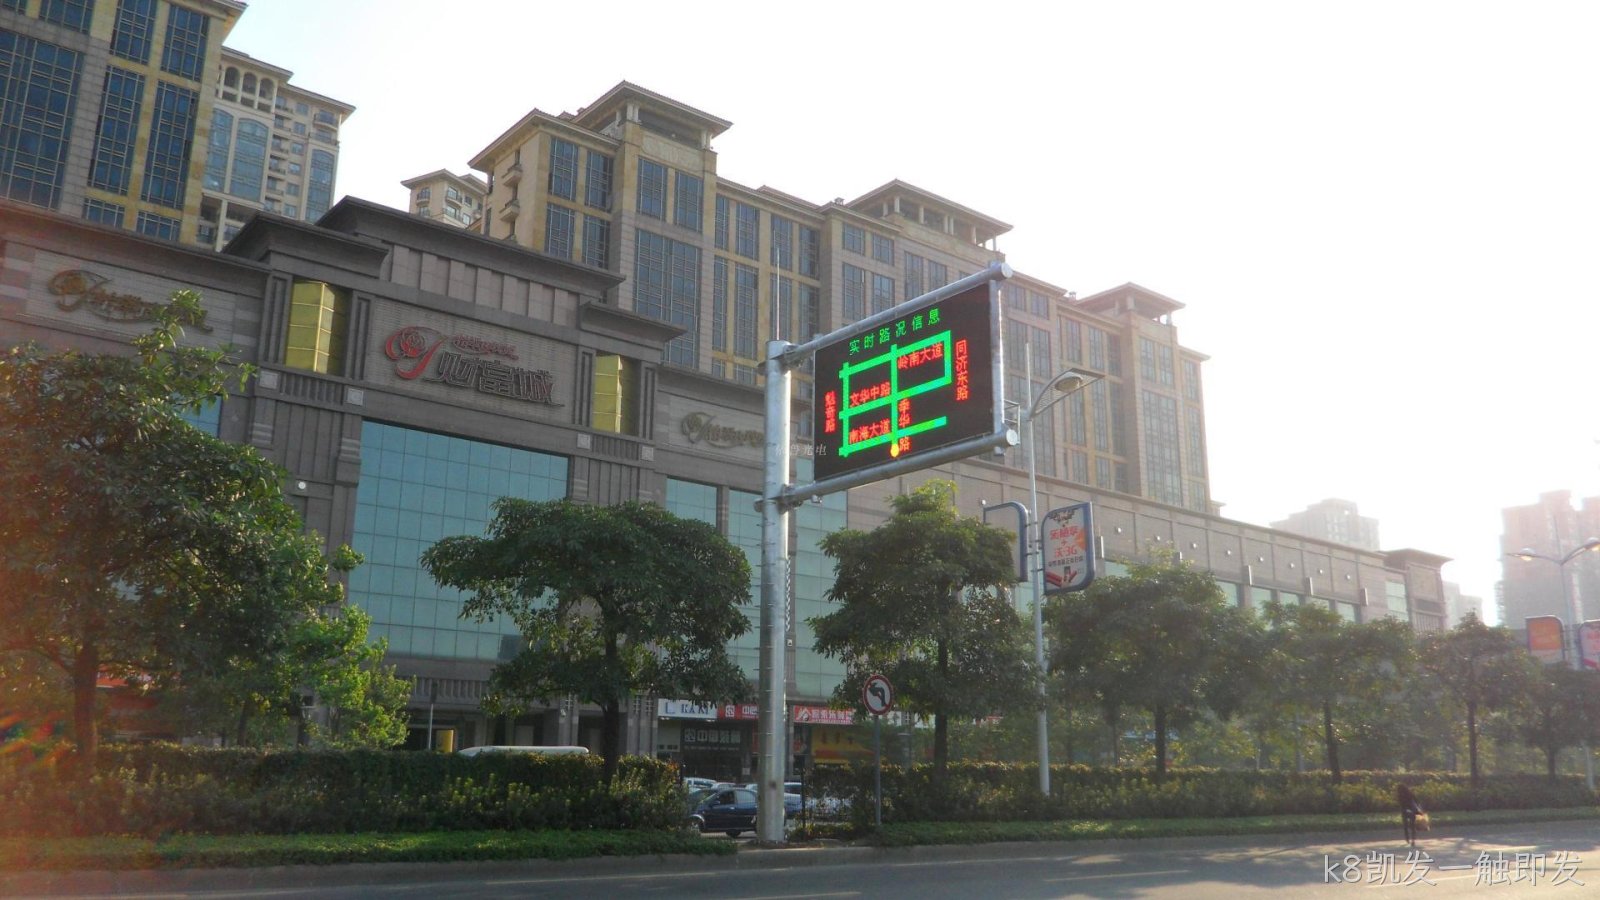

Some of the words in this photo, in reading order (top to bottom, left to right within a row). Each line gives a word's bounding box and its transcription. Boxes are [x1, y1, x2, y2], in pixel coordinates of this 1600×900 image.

[849, 308, 941, 356] 实时路况信息
[430, 351, 556, 405] 财富城
[897, 342, 943, 370] 岭南大道
[955, 339, 970, 401] 同济东路
[824, 391, 837, 433] 魁奇路
[849, 381, 891, 408] 文华中路
[849, 418, 891, 443] 南海大道
[898, 399, 911, 452] 季华路
